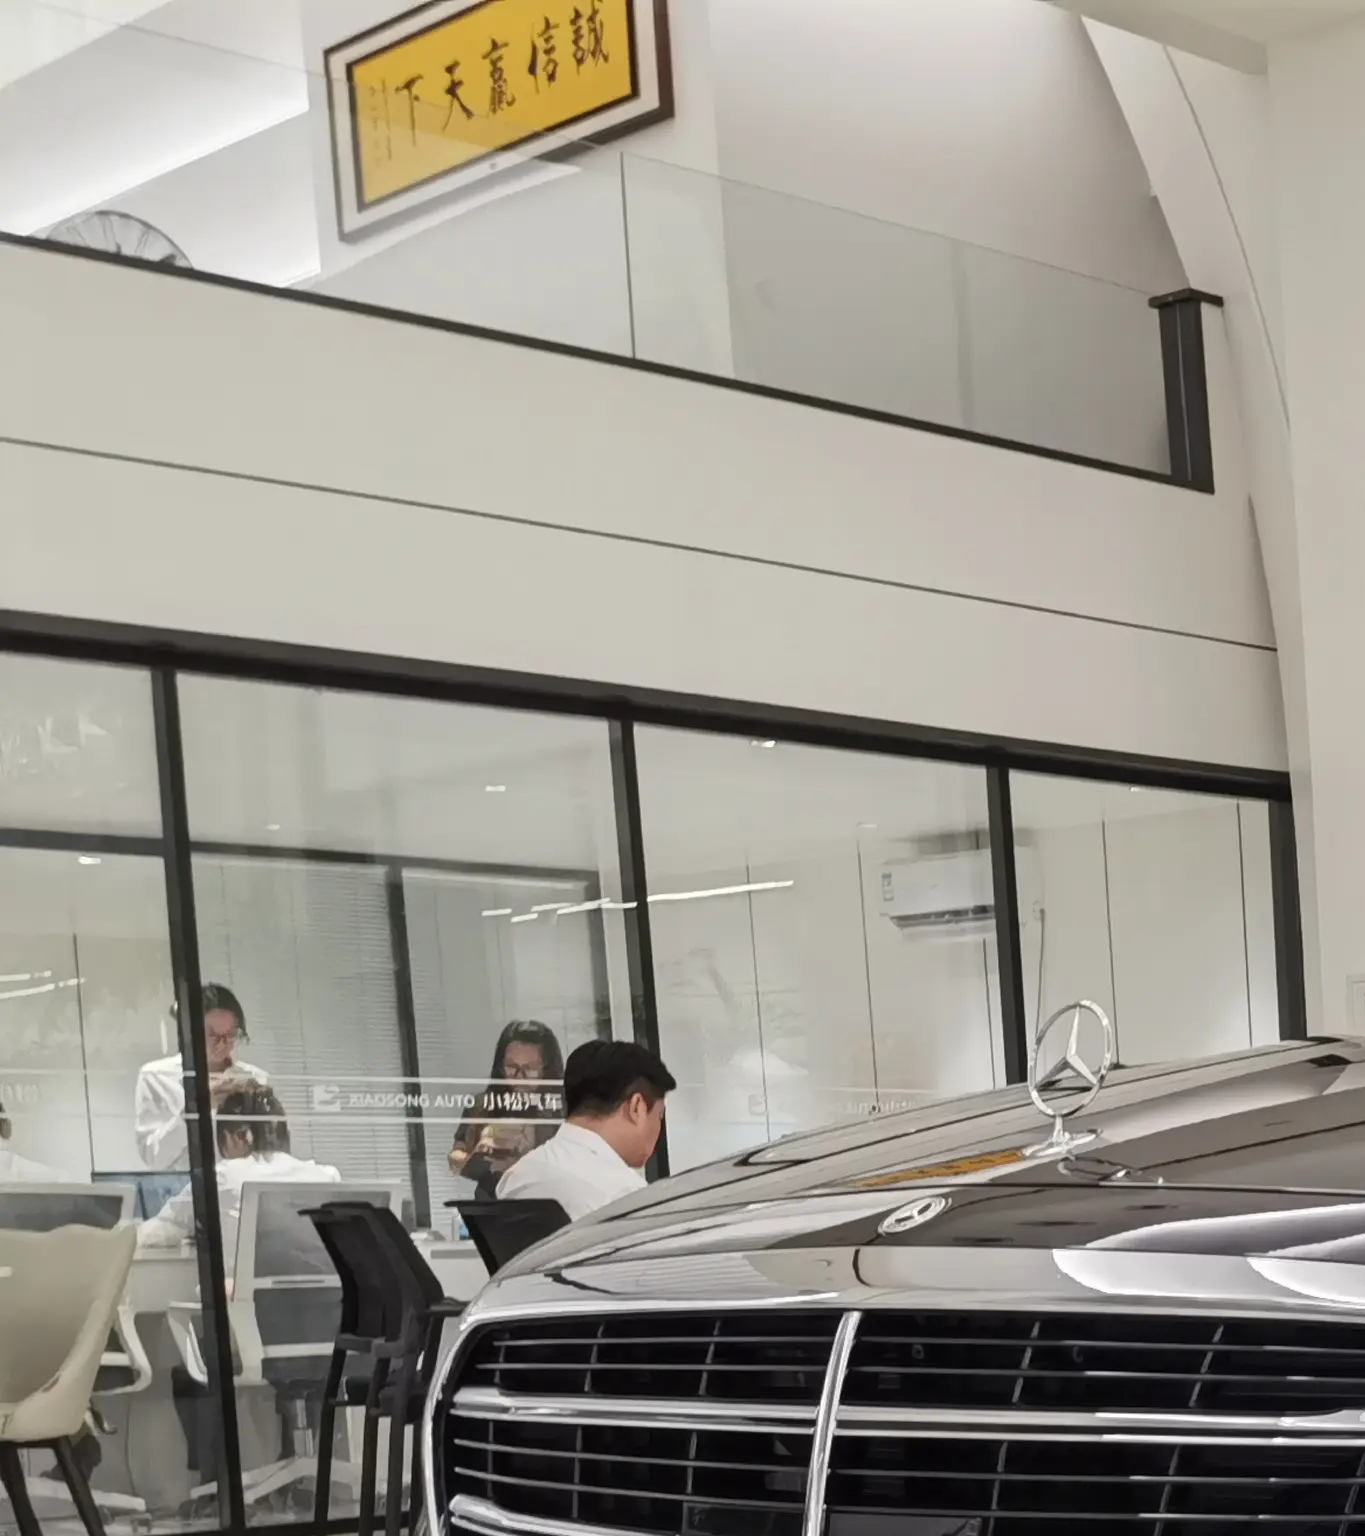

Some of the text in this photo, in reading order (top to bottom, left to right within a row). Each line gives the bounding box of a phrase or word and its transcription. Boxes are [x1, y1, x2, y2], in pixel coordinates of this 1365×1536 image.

[348, 1091, 563, 1112] XIAOSONG AUTO 小松汽车
